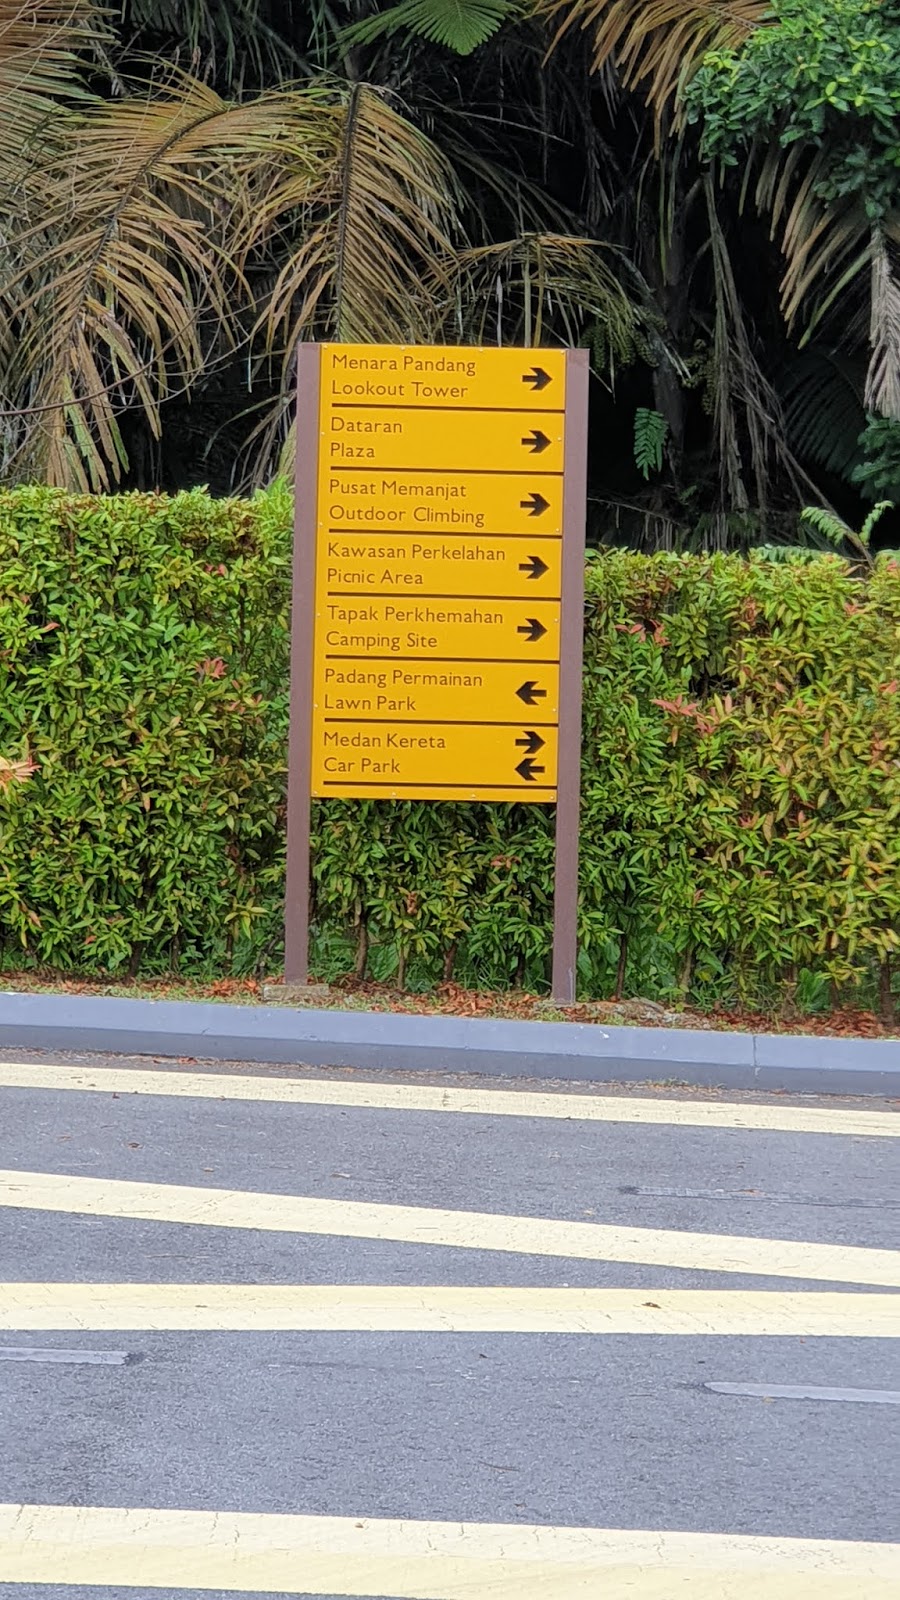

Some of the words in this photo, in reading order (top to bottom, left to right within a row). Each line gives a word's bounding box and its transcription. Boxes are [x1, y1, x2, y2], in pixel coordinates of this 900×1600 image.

[332, 354, 398, 370] Menara
[403, 355, 476, 377] Pandang
[332, 380, 405, 396] Lookout
[411, 381, 468, 398] Tower
[331, 416, 402, 433] Dataran
[330, 442, 375, 458] Plaza
[329, 478, 376, 495] Pusat
[382, 480, 466, 501] Memanjat
[329, 504, 406, 521] Outdoor
[413, 506, 485, 528] Climbing
[328, 542, 406, 558] Kawasan
[412, 544, 505, 561] Perkelahan
[327, 567, 375, 584] Picnic
[380, 569, 423, 585] Area
[326, 604, 378, 625] Tapak
[385, 606, 503, 624] Perkhemahan
[326, 630, 401, 652] Camping
[406, 632, 438, 648] Site
[325, 668, 387, 689] Padang
[392, 669, 483, 687] Permainan
[324, 694, 371, 710] Lawn
[377, 695, 416, 711] Park
[323, 731, 381, 748] Medan
[386, 733, 446, 749] Kereta
[323, 756, 355, 772] Car
[361, 757, 401, 773] Park
